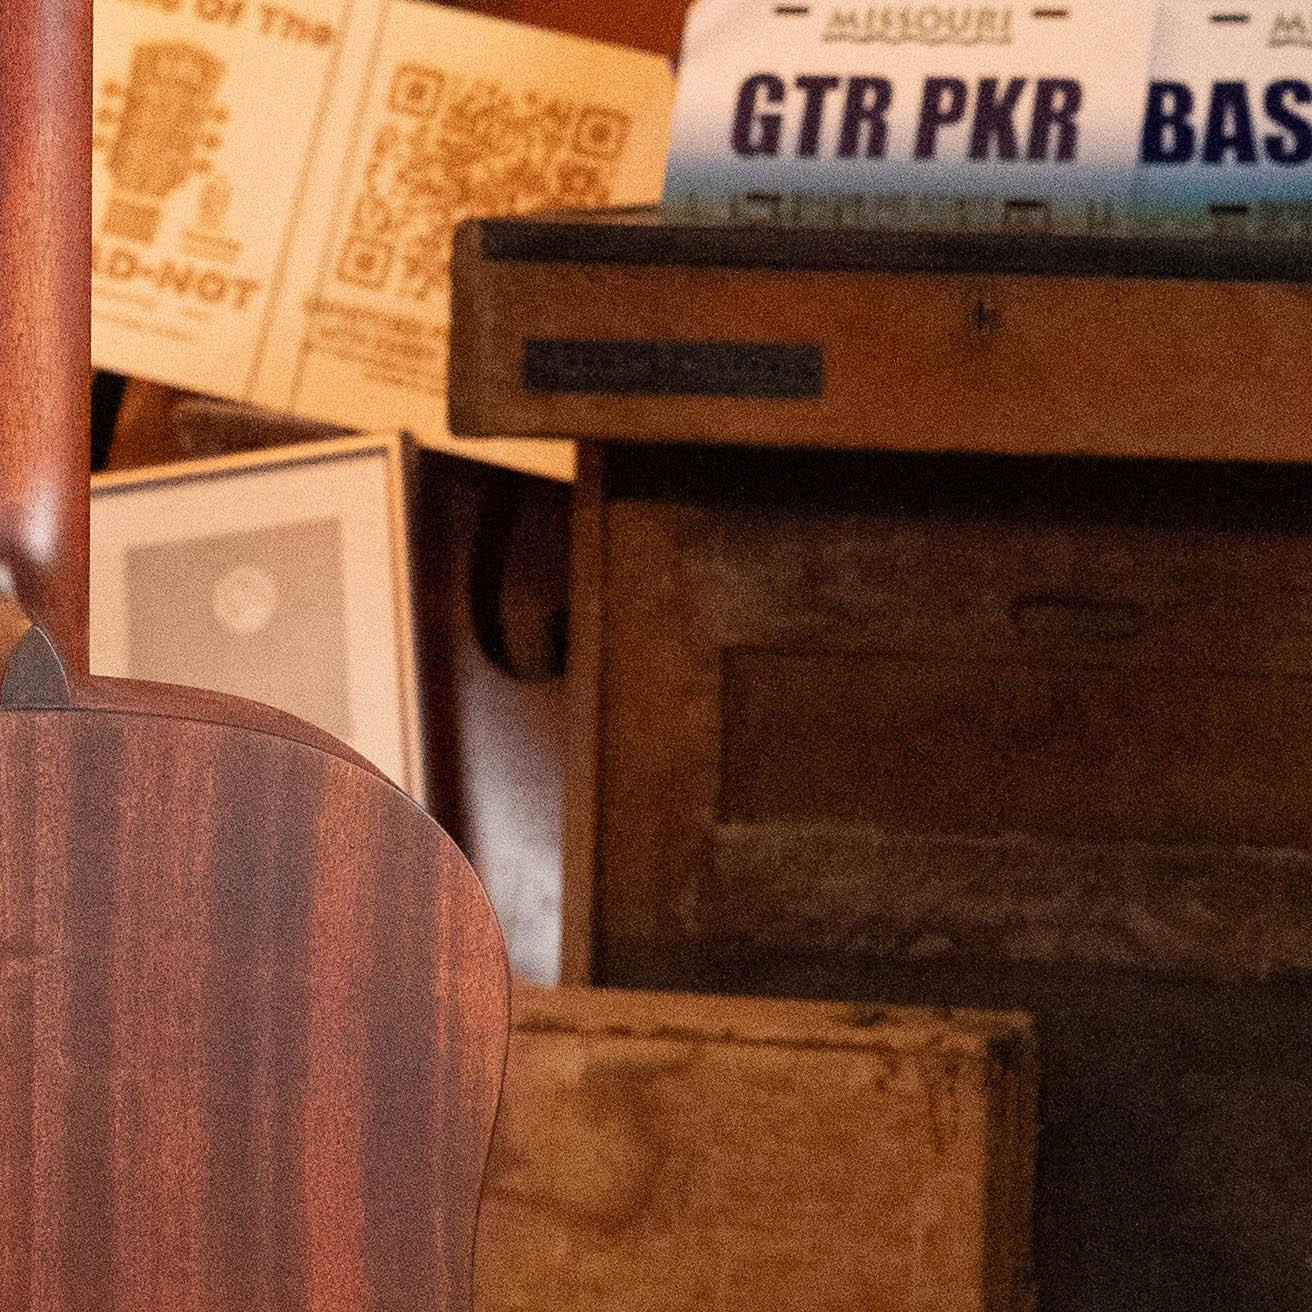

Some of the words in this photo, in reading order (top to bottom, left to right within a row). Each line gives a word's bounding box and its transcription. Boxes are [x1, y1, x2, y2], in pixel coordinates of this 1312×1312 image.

[258, 2, 335, 48] The
[826, 5, 1013, 37] MISSOURI
[729, 73, 894, 159] GTR
[913, 75, 1084, 162] PKR
